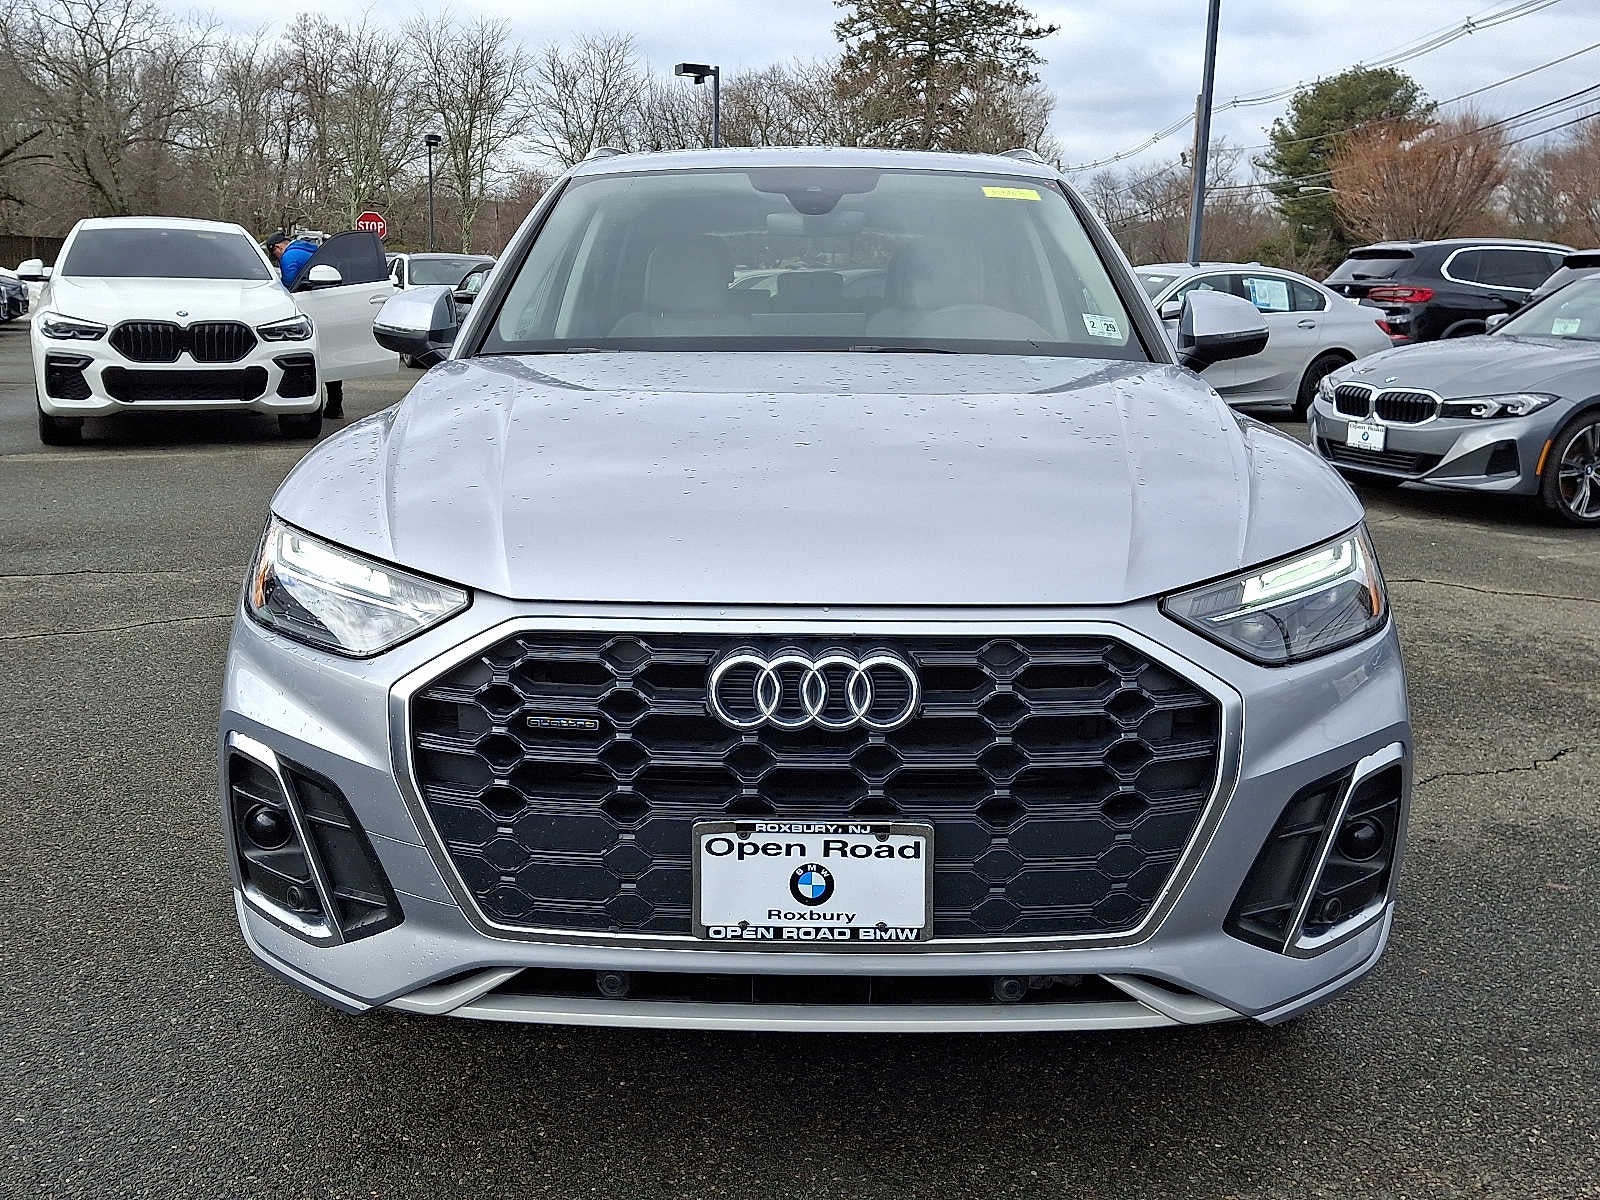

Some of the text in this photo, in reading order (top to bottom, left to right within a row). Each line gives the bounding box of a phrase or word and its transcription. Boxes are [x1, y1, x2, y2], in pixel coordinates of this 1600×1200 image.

[358, 221, 384, 233] STOP
[1089, 320, 1116, 332] 2 29
[755, 823, 871, 834] ROXBURY, NJ
[705, 837, 921, 860] Open Road
[795, 864, 830, 877] BMW
[767, 909, 857, 924] Roxbury
[708, 926, 918, 940] OPEN ROAD BMW
